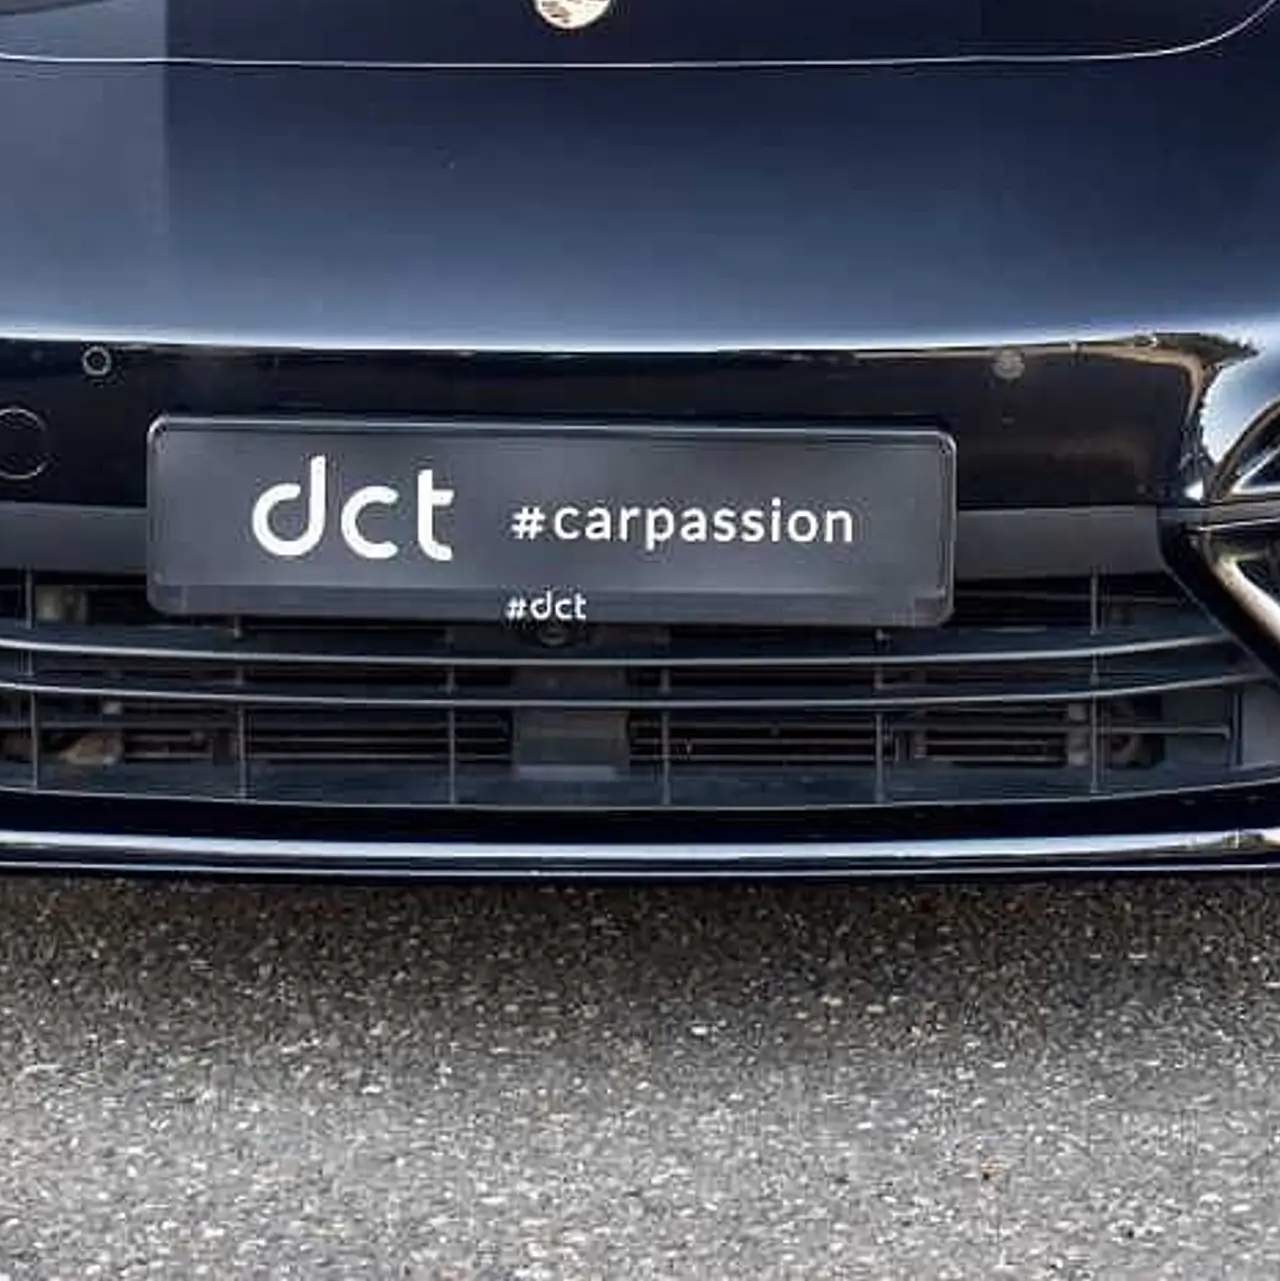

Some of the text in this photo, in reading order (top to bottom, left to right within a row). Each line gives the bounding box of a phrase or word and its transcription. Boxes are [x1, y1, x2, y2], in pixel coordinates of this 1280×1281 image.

[251, 455, 853, 562] dct #carpassion
[506, 590, 588, 621] #dct
